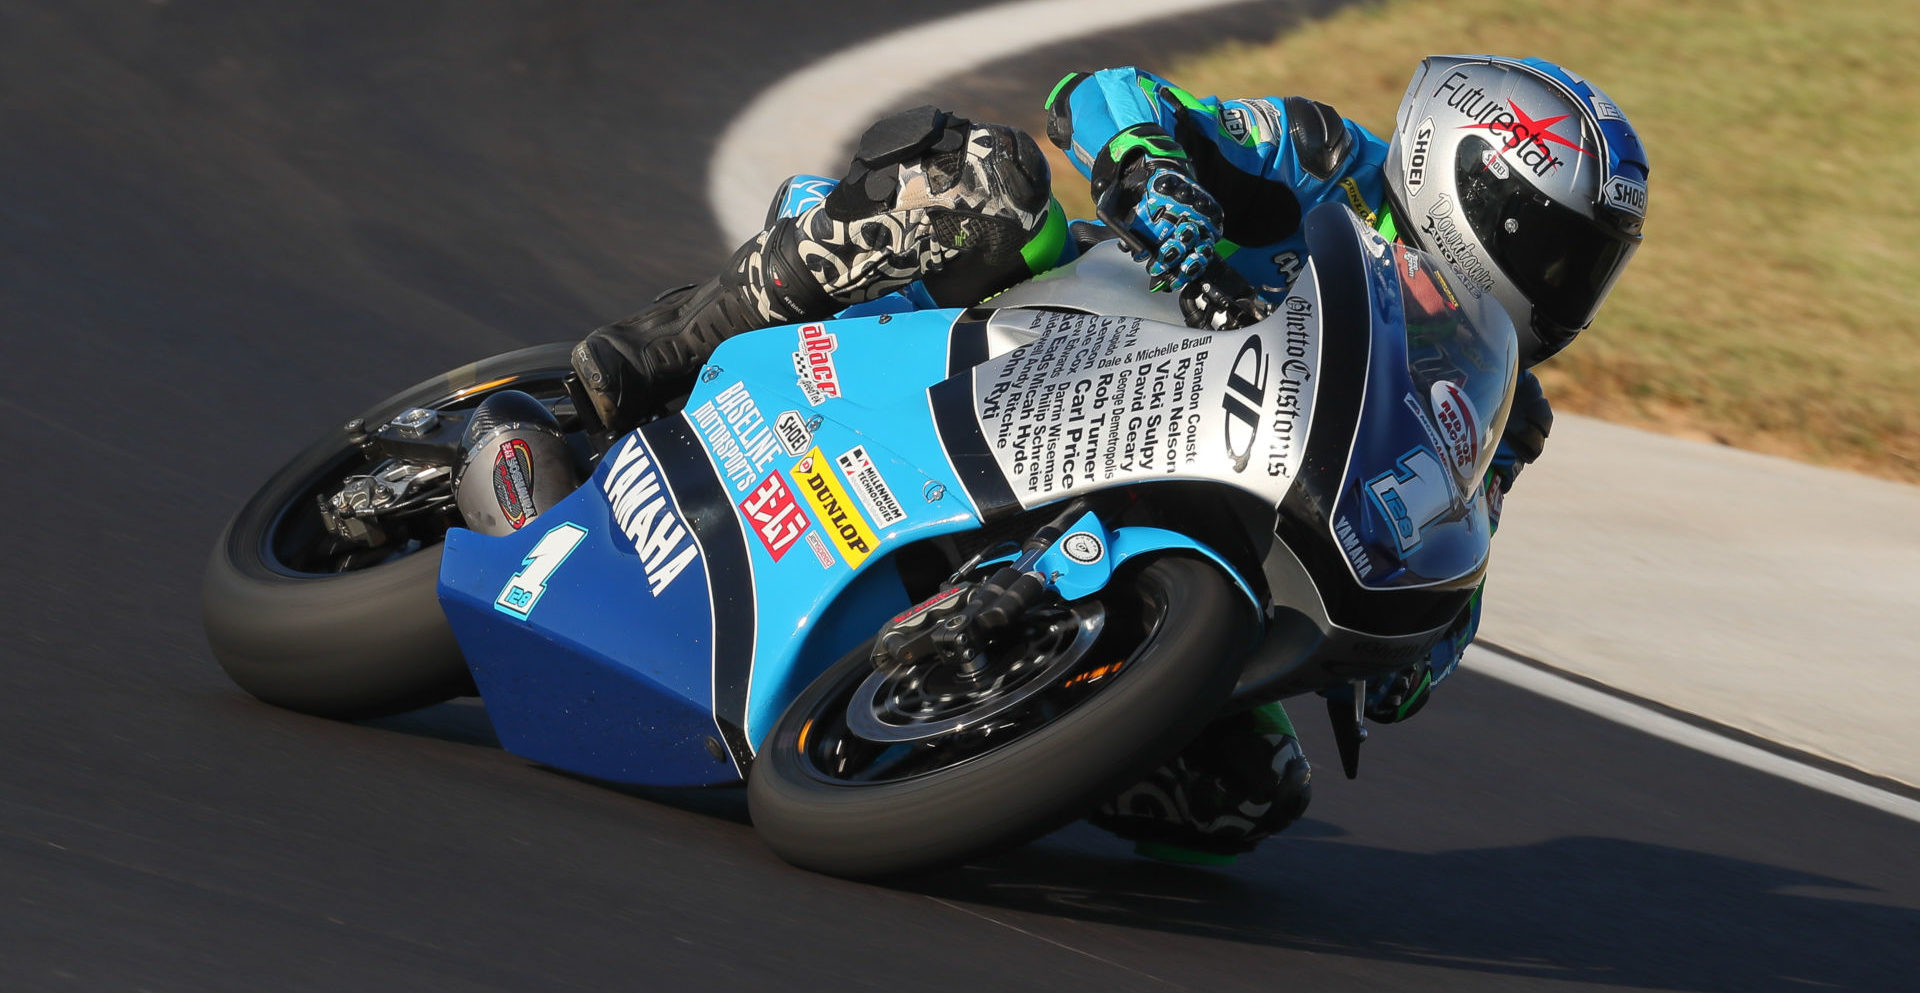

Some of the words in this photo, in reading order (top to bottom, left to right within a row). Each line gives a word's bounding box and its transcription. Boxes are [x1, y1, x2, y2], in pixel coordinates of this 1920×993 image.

[1433, 71, 1564, 178] Futurestar
[1408, 127, 1432, 186] SHOEI
[1429, 193, 1495, 292] Downtown
[1429, 227, 1453, 262] AUTO
[1067, 349, 1089, 376] Cox
[1084, 319, 1112, 370] Jenson
[1097, 356, 1121, 369] Dale
[1124, 353, 1133, 364] &
[1135, 342, 1178, 362] Michelle
[1181, 335, 1212, 350] Braun
[1011, 358, 1039, 388] Andy
[1020, 373, 1044, 420] Micah
[1093, 373, 1114, 409] Rob
[1112, 369, 1132, 406] George
[1131, 363, 1152, 413] David
[1150, 359, 1171, 410] Vicki
[1173, 357, 1191, 402] Ryan
[1189, 351, 1208, 410] Brandon
[982, 381, 1011, 420] Ryti
[996, 392, 1022, 449] Ritchie
[1033, 383, 1056, 421] Philip
[1051, 381, 1071, 421] Darrin
[1069, 379, 1092, 422] Carl
[1441, 400, 1461, 432] RED
[690, 400, 757, 492] MOTORSPORTS
[715, 380, 783, 474] BASELINE
[779, 416, 807, 451] SHOEI
[1012, 424, 1032, 475] Hyde
[1084, 413, 1106, 481] Turner
[1103, 407, 1124, 480] Demetropolis
[1120, 416, 1142, 472] Geary
[1139, 414, 1161, 470] Sulpy
[1167, 406, 1184, 474] Nelson
[1029, 425, 1047, 492] Schreier
[1044, 423, 1062, 492] Wiseman
[1062, 427, 1083, 489] Price
[603, 434, 699, 598] YAMAHA
[807, 473, 870, 553] DUNLOP
[858, 472, 894, 522] TECHNOLOGIES
[864, 467, 902, 519] MILLENNIUM
[1381, 487, 1413, 538] 128
[495, 522, 588, 620] 1
[1335, 515, 1373, 579] YAMAHA
[504, 585, 533, 608] 128
